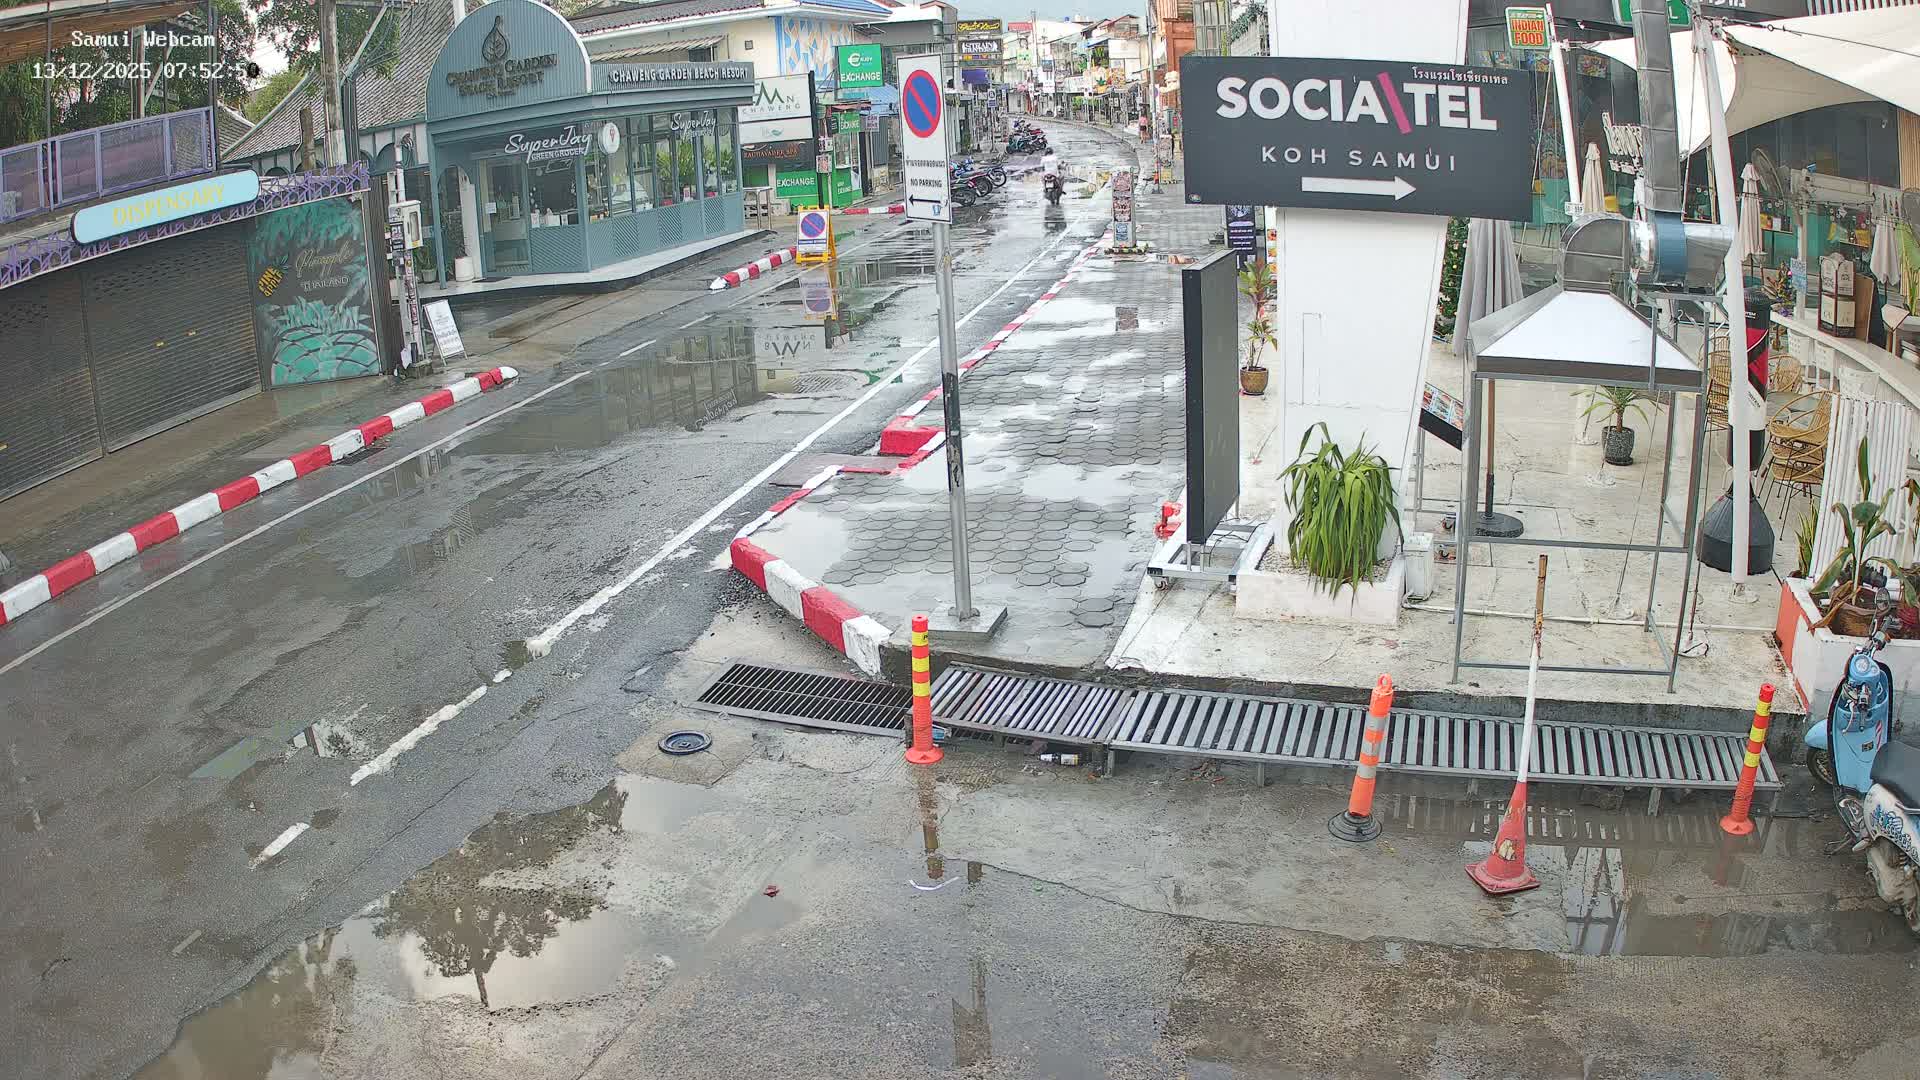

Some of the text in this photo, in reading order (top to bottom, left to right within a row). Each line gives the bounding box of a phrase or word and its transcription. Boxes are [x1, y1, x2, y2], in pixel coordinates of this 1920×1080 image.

[1511, 19, 1544, 31] INDIAN
[1514, 31, 1544, 46] FOOD
[504, 53, 558, 73] GARDEN
[611, 66, 749, 83] CHAWENG GARDEN BEACH RESORT
[840, 71, 881, 82] EXCHANGE
[1411, 66, 1508, 85] โรงแรมโซเชียลเทล
[742, 103, 801, 114] CHAWENG
[1261, 145, 1456, 173] KOH SAMUI
[776, 177, 815, 188] EXCHANGE
[910, 178, 943, 188] NO PARKING
[112, 182, 225, 228] DISPENSARY
[258, 266, 281, 292] PINE
[301, 275, 350, 292] THAILAND
